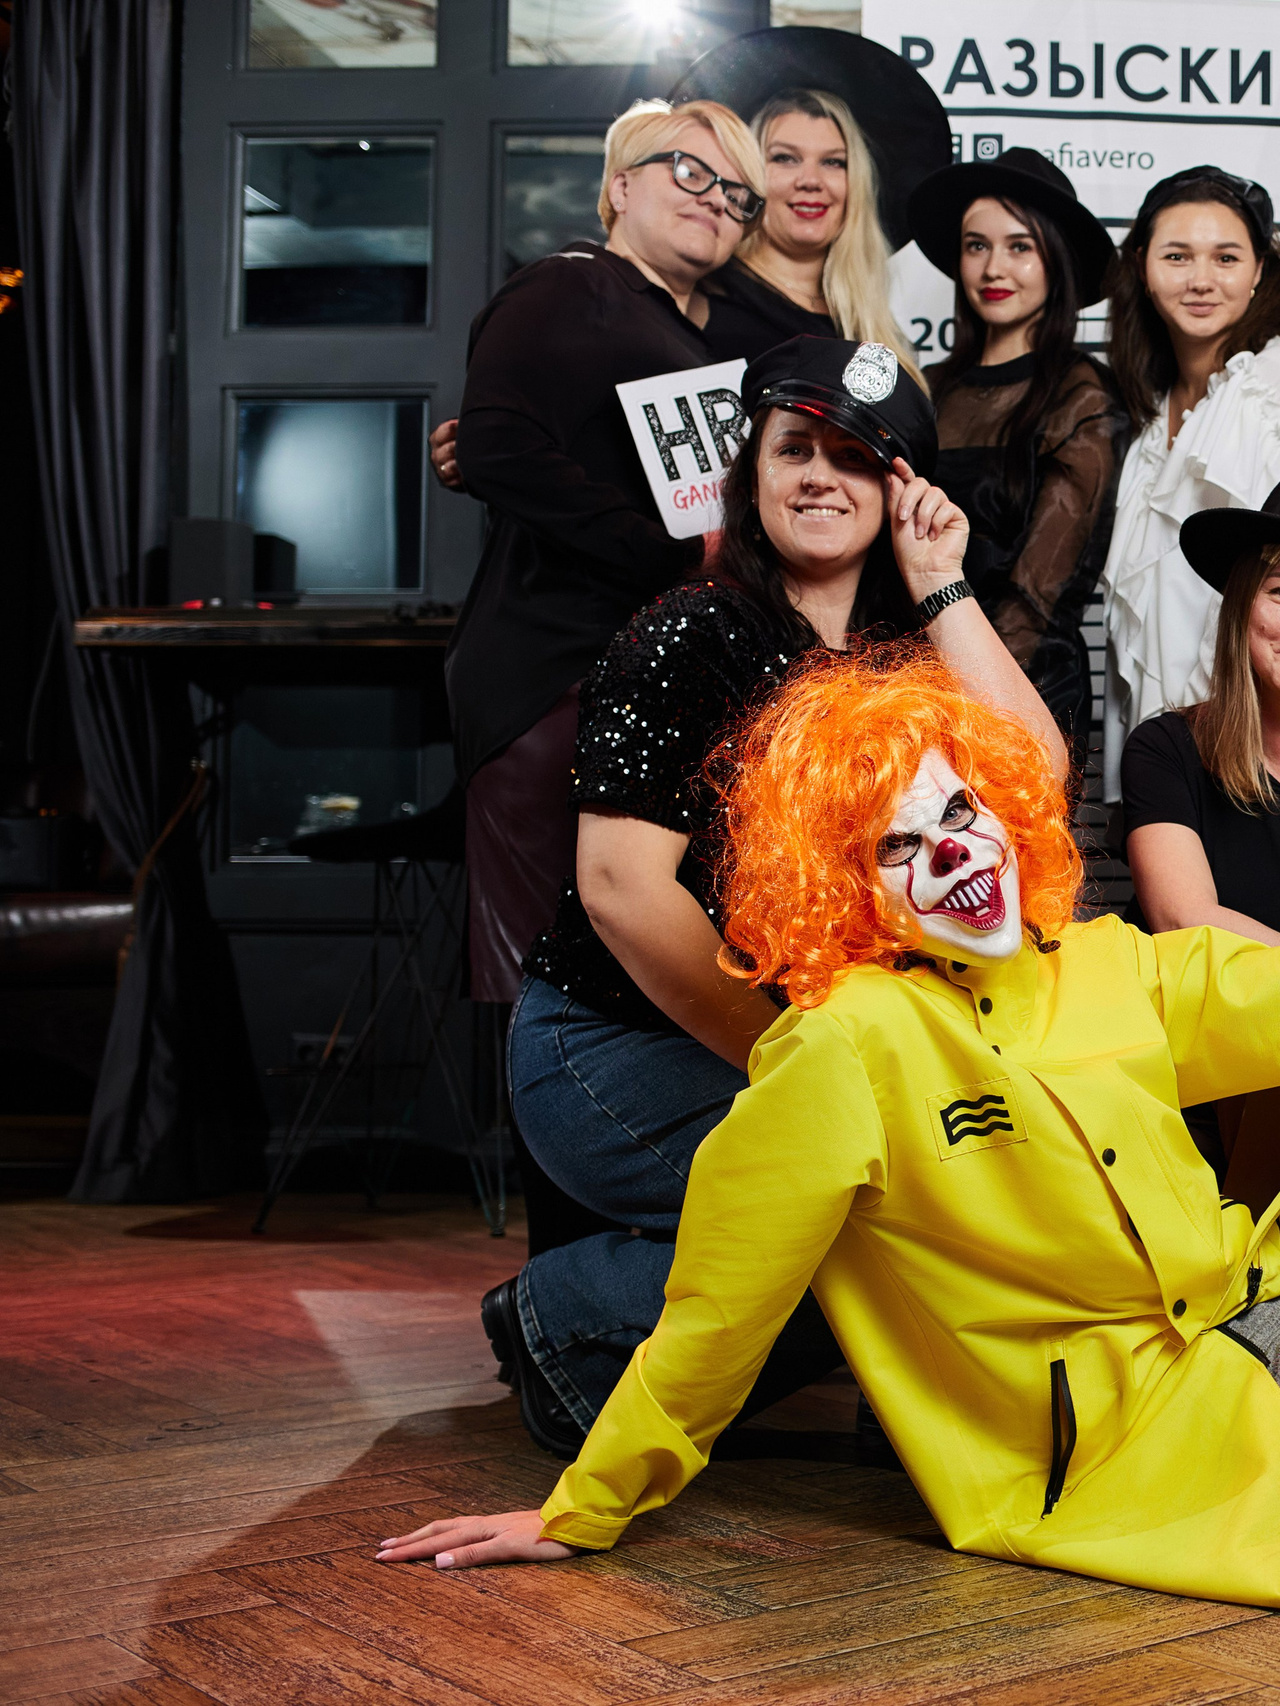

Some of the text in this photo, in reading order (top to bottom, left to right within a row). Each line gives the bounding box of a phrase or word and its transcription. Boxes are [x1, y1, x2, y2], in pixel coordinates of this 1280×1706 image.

[1042, 141, 1155, 171] afiavero
[642, 388, 752, 483] HR
[673, 478, 726, 510] GAN
